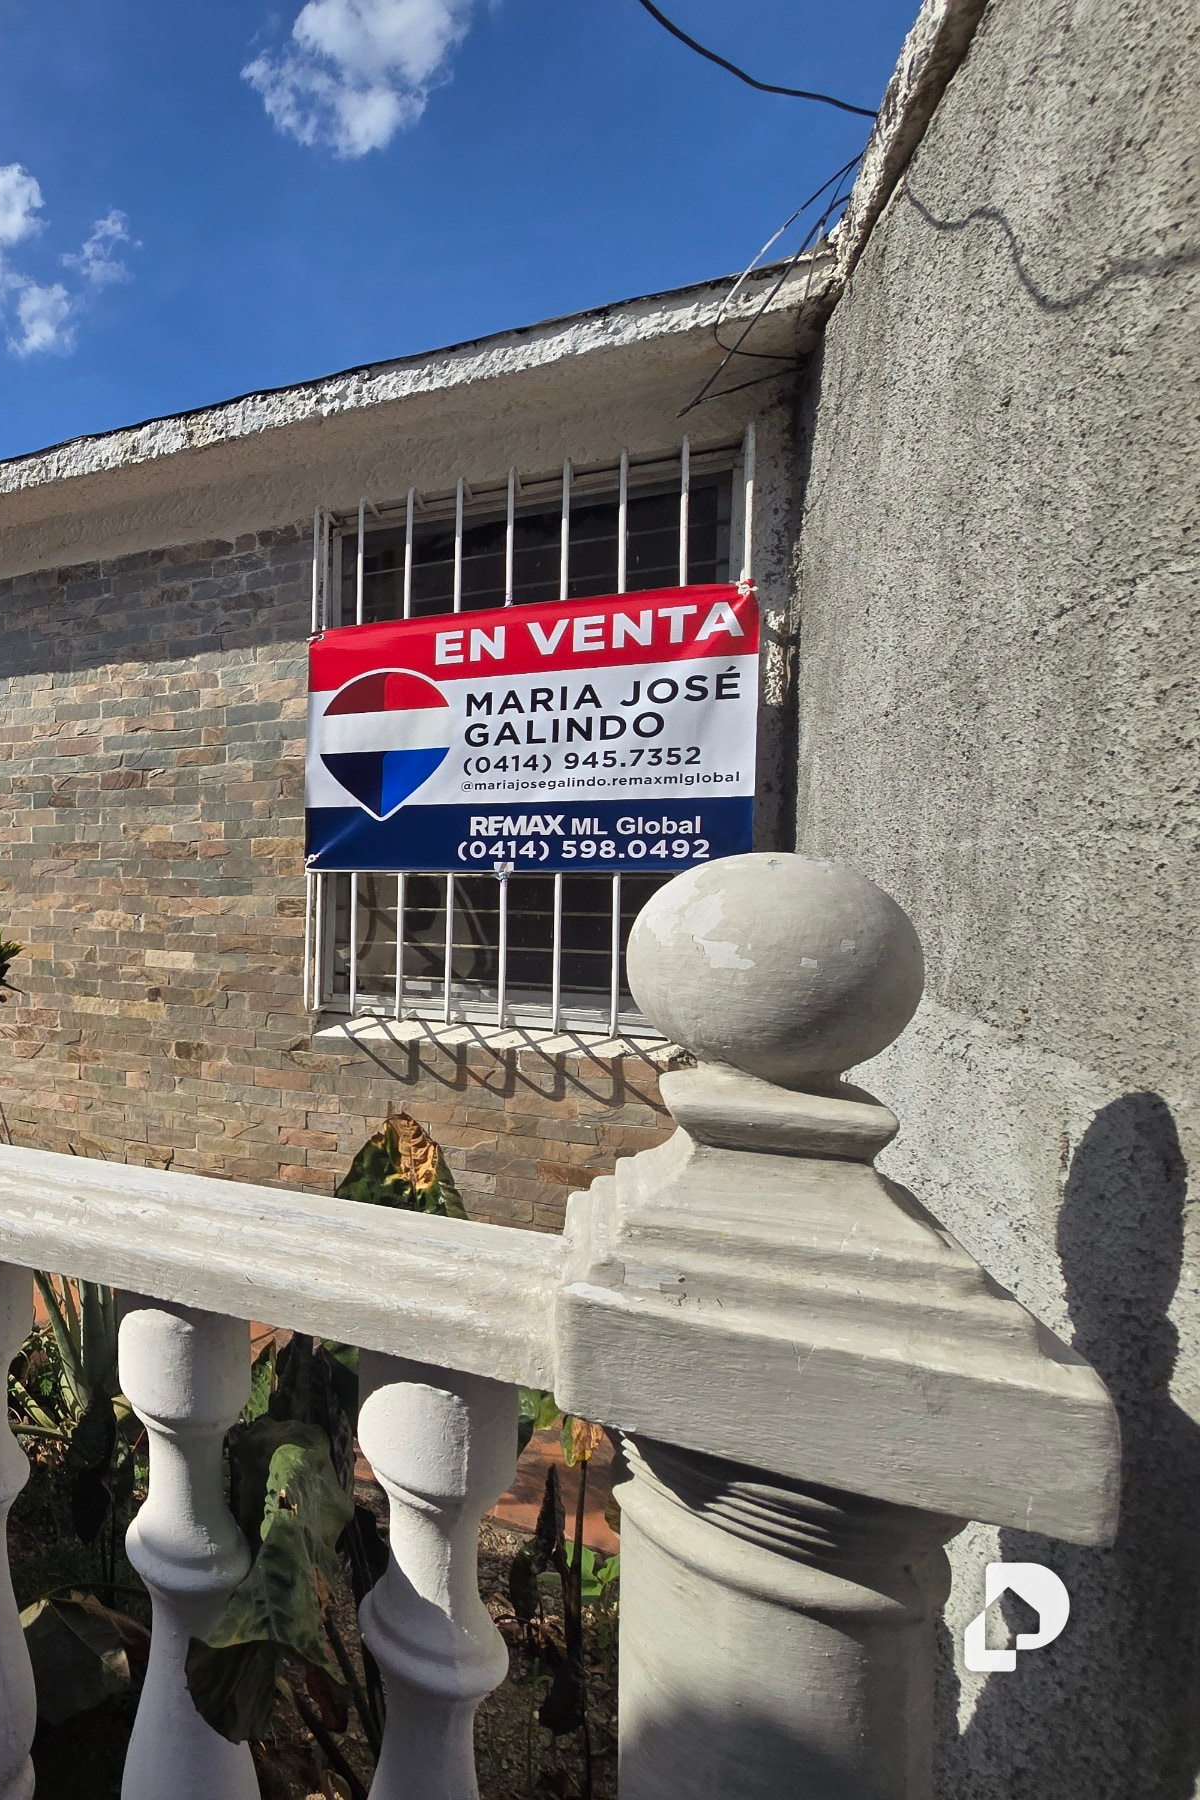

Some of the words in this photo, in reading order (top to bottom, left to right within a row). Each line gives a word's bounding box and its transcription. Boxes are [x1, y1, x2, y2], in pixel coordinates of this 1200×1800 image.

[434, 625, 506, 666] EN
[526, 601, 745, 656] VENTA
[465, 684, 603, 717] MARIA
[620, 665, 742, 707] JOSÉ
[464, 711, 665, 748] GALINDO
[463, 753, 553, 777] (0414)
[563, 746, 702, 771] 945.7352
[460, 771, 741, 793] @mariajosegalindo.remaxmlglobal
[469, 814, 566, 837] REMAX
[571, 817, 608, 836] ML
[615, 815, 702, 836] Global
[457, 839, 550, 862] (0414)
[560, 838, 711, 860] 598.0492
